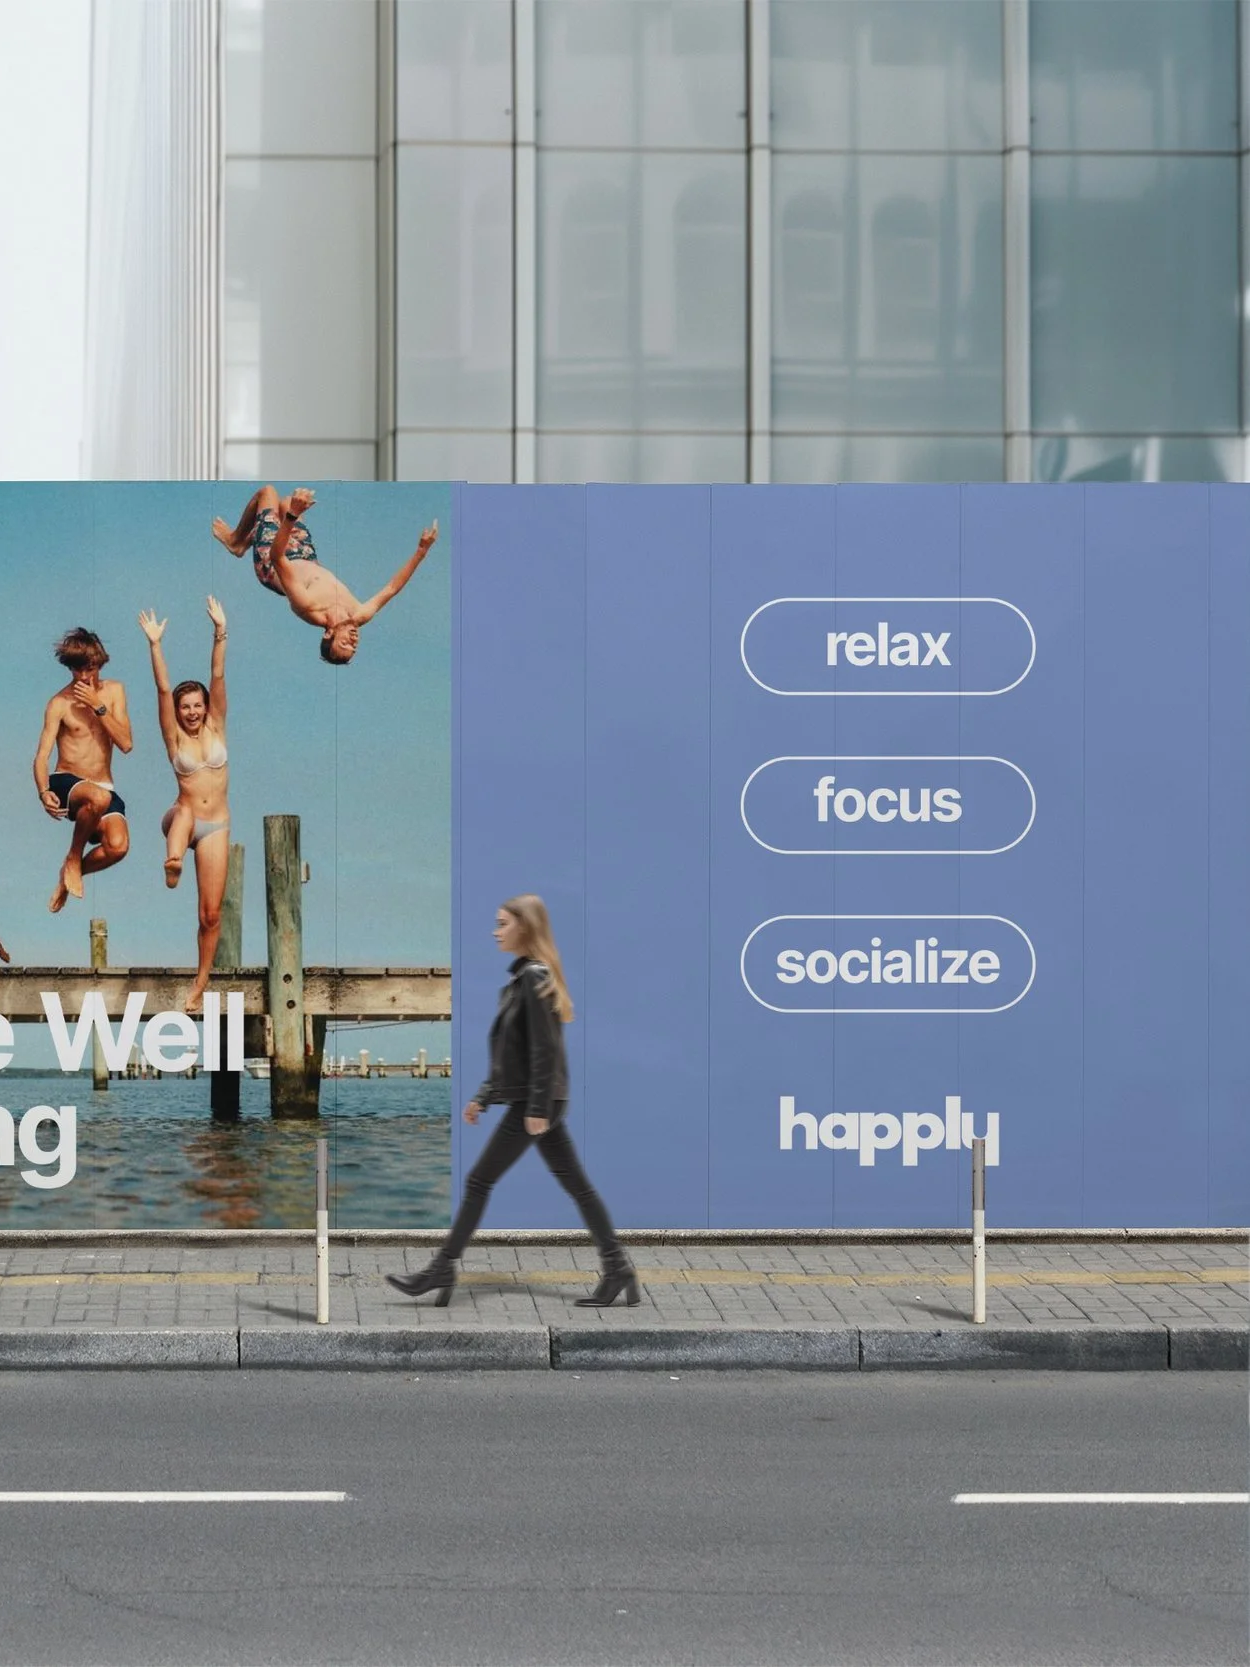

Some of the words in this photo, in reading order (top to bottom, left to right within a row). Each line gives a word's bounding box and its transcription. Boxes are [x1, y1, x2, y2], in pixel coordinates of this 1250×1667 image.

[826, 622, 951, 666] relax
[813, 775, 962, 823] focus
[776, 937, 1000, 984] socialize
[40, 992, 244, 1072] Well
[779, 1095, 1000, 1167] happly
